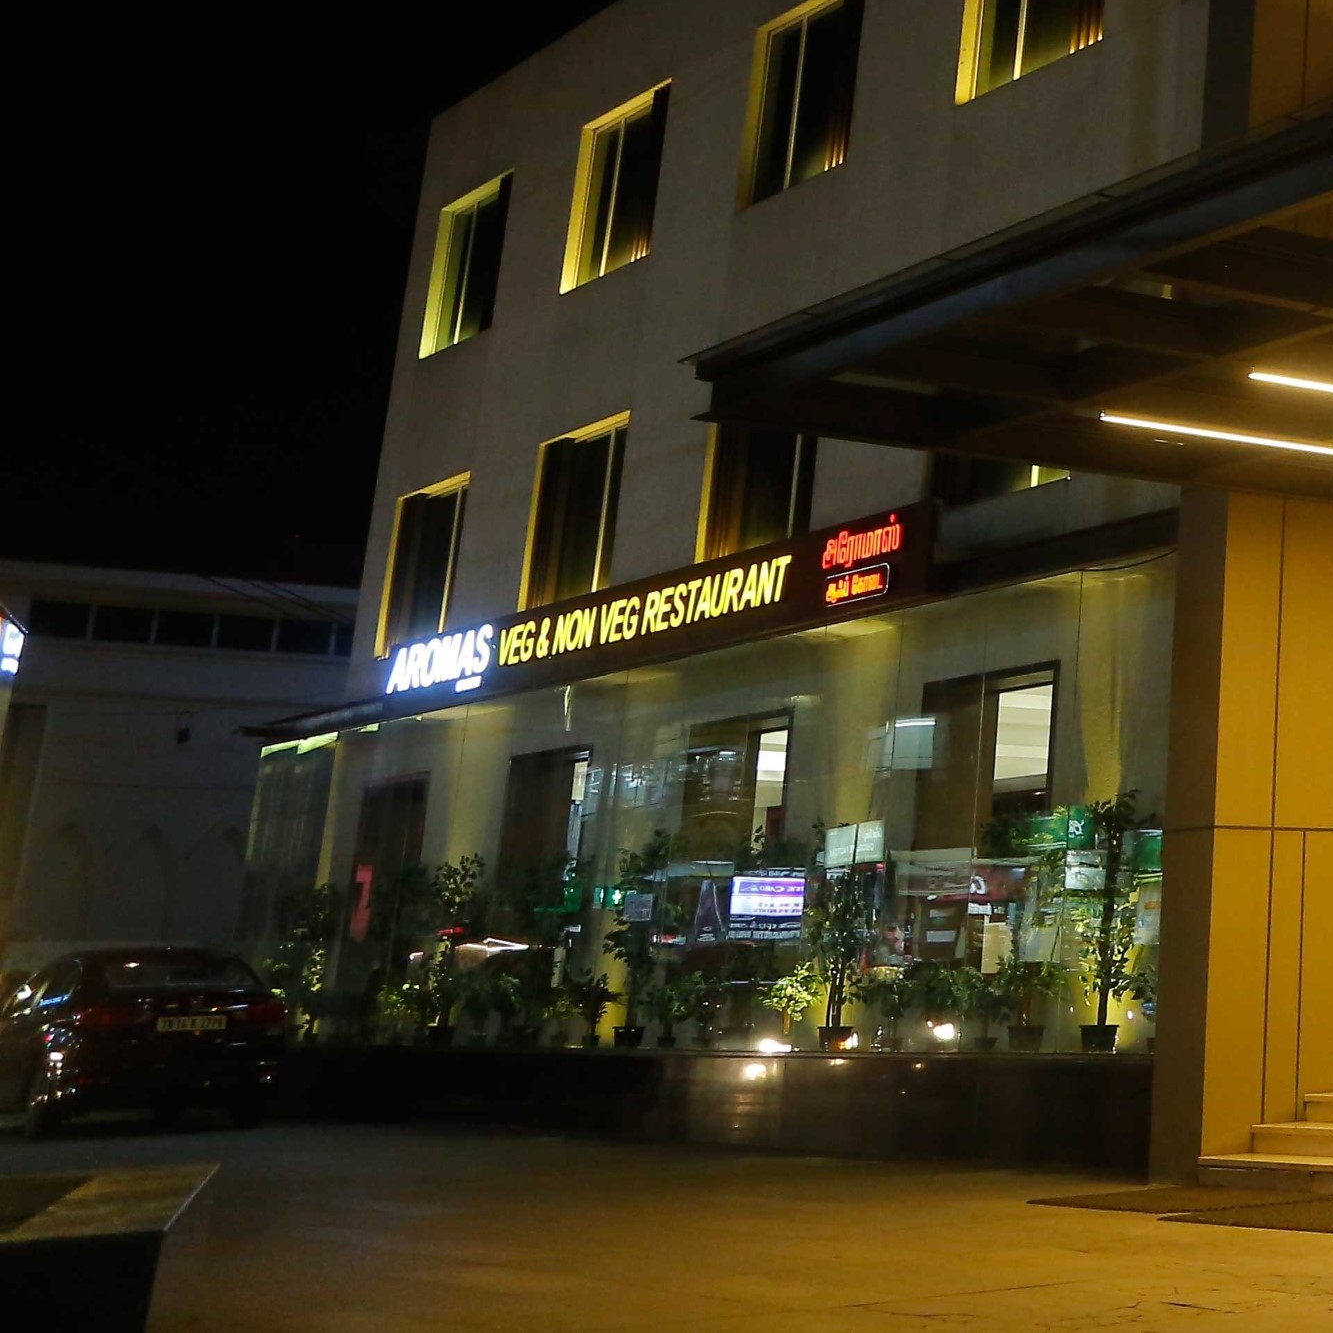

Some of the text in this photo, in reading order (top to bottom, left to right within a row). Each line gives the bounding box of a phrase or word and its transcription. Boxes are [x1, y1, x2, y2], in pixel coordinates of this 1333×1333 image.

[385, 554, 792, 695] AROMAS VEG & NON VEG RESTAURANT
